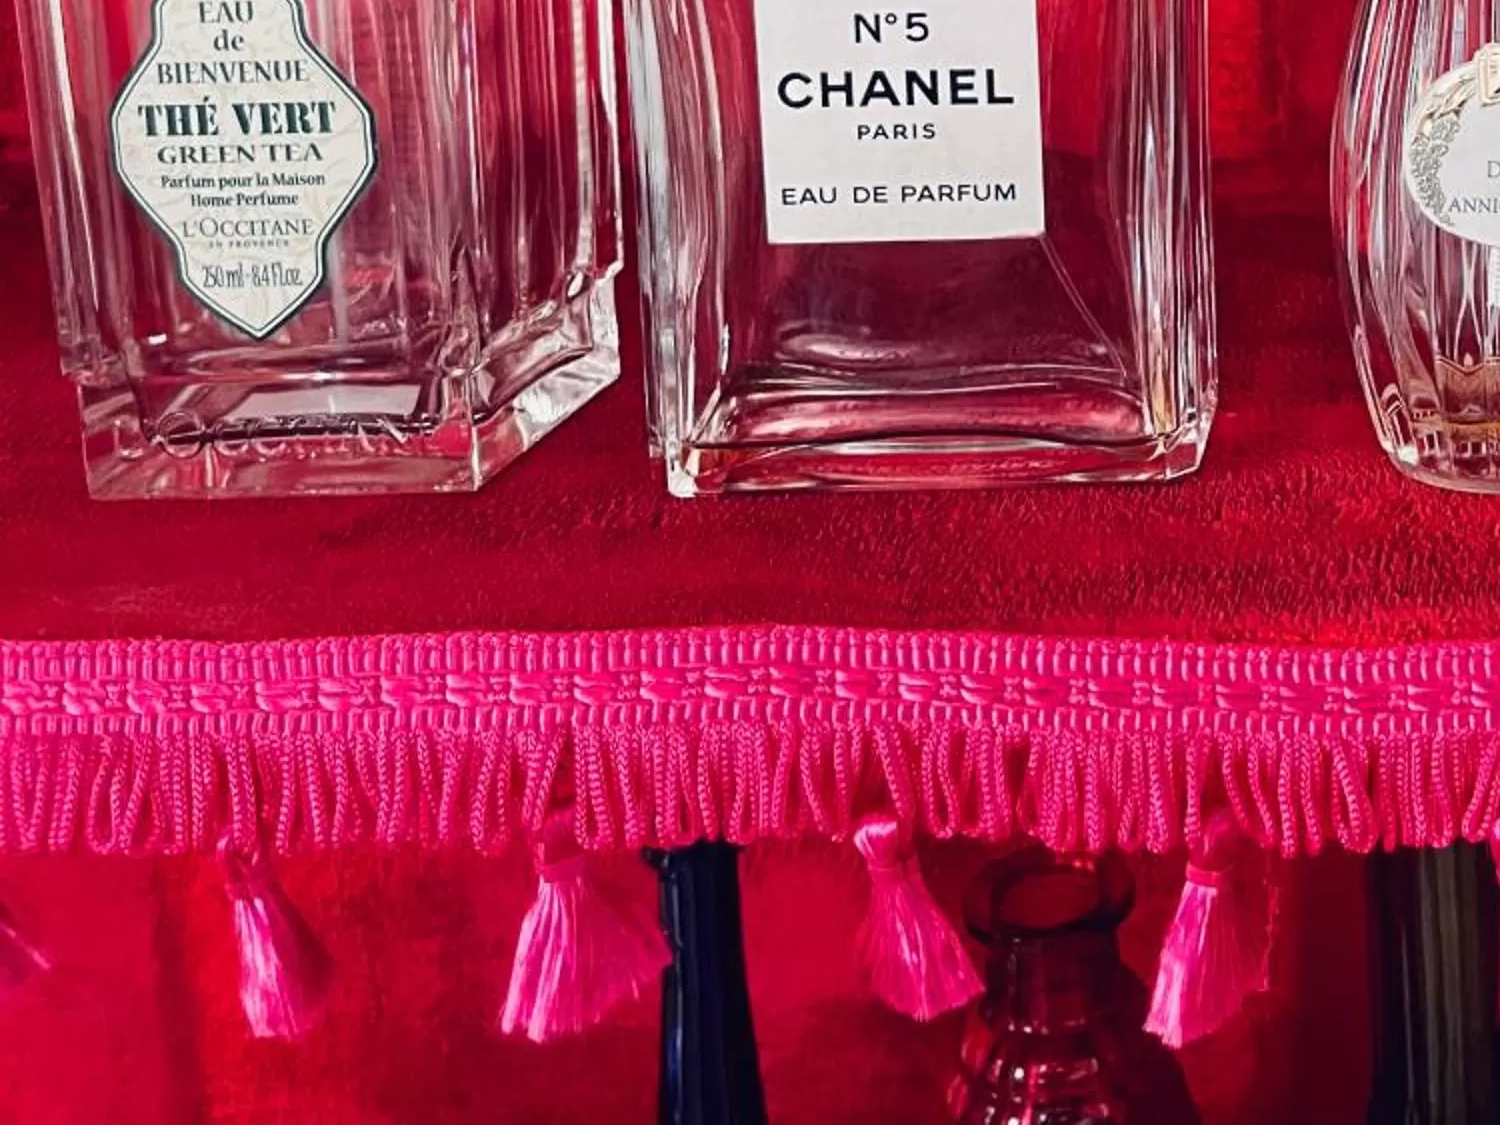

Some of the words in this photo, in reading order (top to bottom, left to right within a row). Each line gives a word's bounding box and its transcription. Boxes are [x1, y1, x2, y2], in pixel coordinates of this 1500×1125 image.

[198, 0, 254, 24] EAU
[213, 29, 245, 52] de
[157, 59, 310, 84] BIENVENUE
[777, 68, 1015, 109] CHANEL
[137, 96, 219, 137] THÉ
[232, 100, 337, 135] VERT
[857, 124, 937, 141] PARIS
[157, 144, 258, 165] GREEN
[262, 142, 323, 162] TEA
[161, 175, 216, 189] Parfum
[219, 174, 253, 191] pour
[256, 172, 270, 187] la
[272, 172, 326, 187] Maison
[191, 193, 233, 208] Home
[236, 191, 299, 207] Perfume
[781, 187, 838, 206] EAU
[853, 186, 889, 204] DE
[901, 183, 1018, 203] PARFUM
[183, 217, 315, 238] L'OCCITANE
